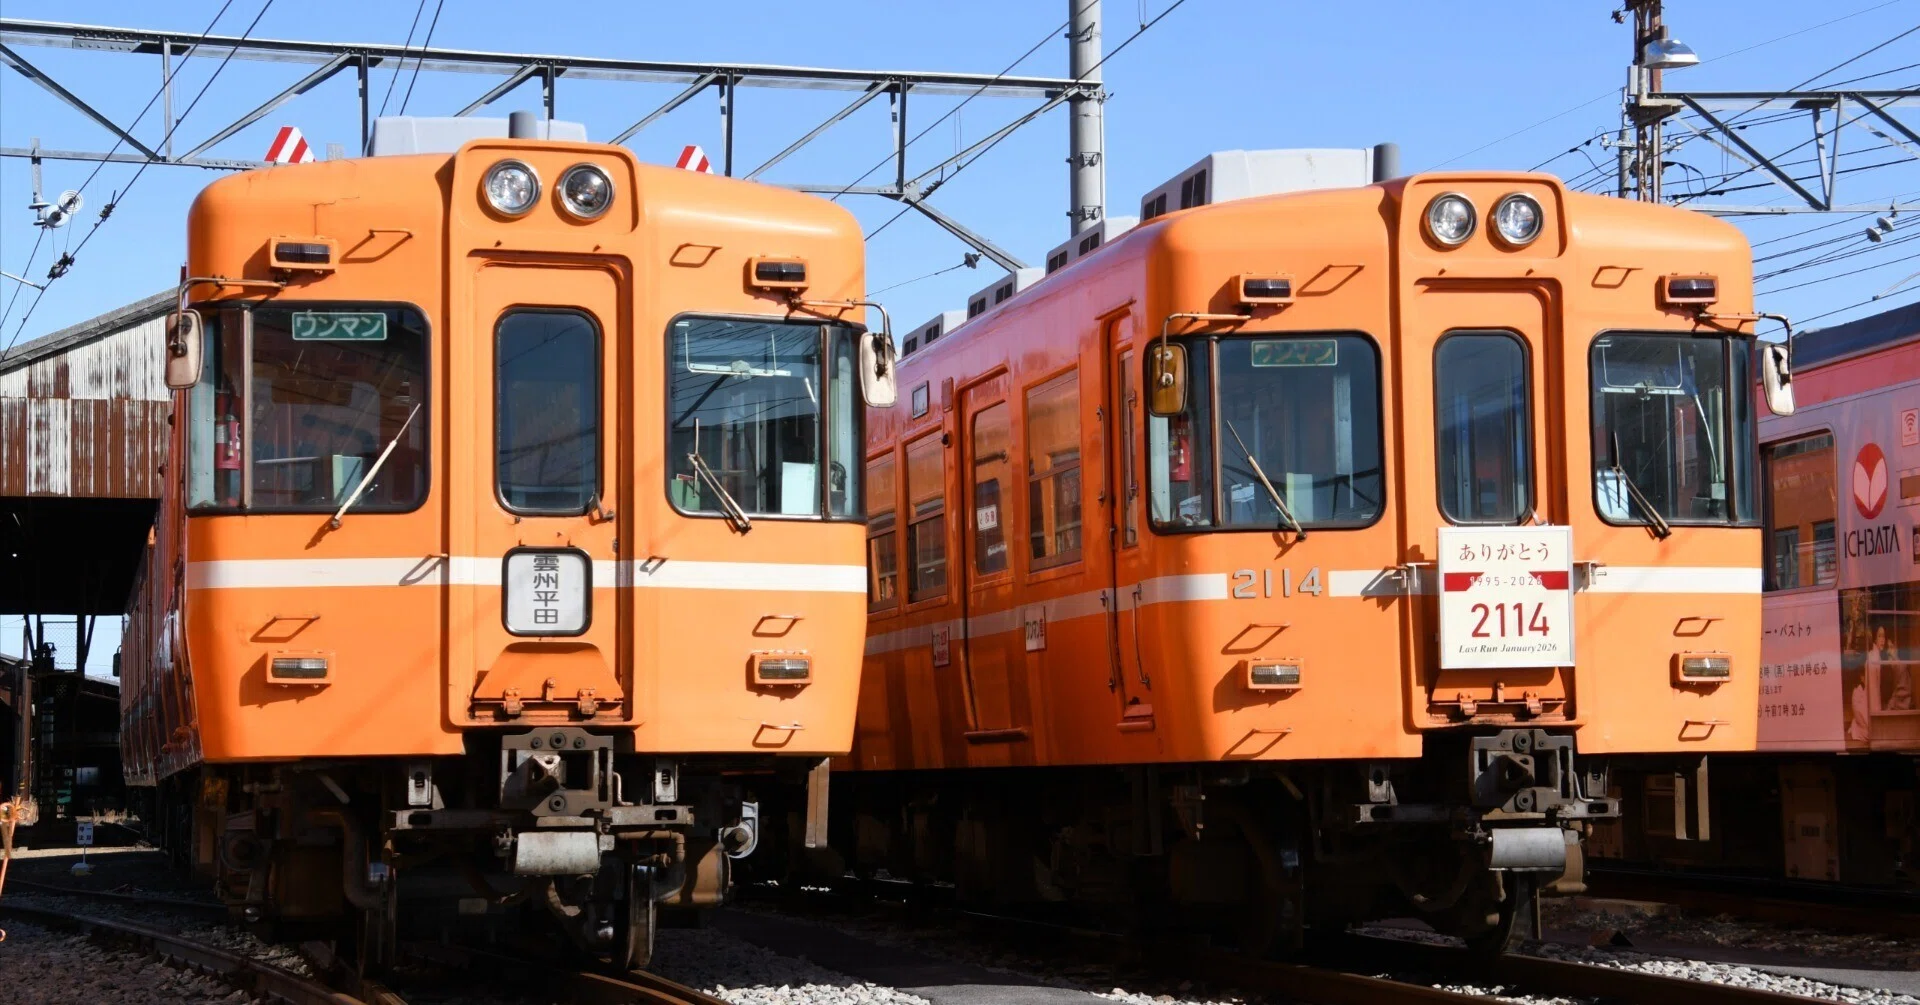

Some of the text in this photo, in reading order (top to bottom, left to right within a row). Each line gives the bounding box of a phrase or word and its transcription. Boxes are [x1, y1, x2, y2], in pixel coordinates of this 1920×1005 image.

[296, 316, 382, 337] ワンマン
[1459, 543, 1549, 562] ありがとう
[533, 555, 560, 624] 雲州平田
[1232, 567, 1323, 599] 2114
[1469, 575, 1543, 586] 1995-2026
[1471, 602, 1550, 637] 2114
[1459, 643, 1557, 654] Last Run January 2026
